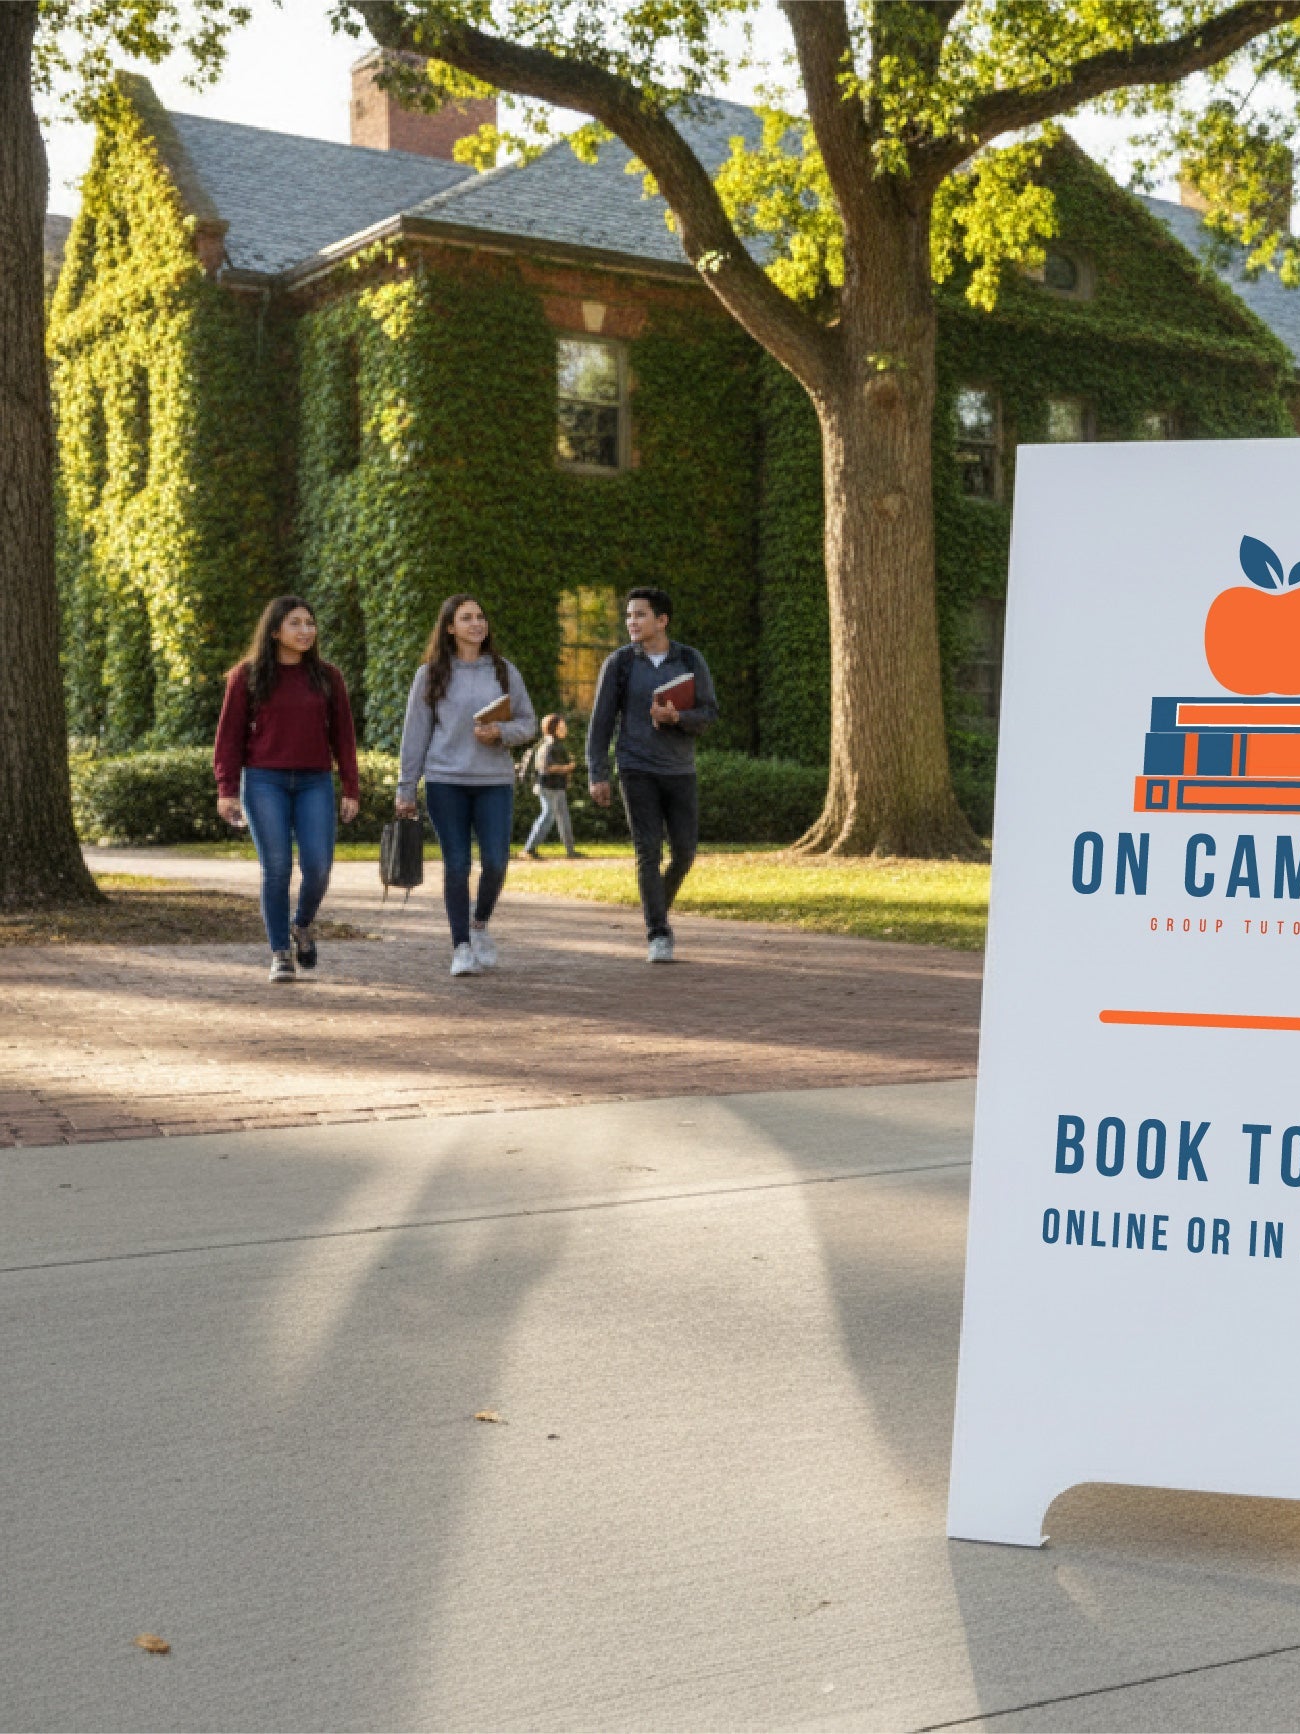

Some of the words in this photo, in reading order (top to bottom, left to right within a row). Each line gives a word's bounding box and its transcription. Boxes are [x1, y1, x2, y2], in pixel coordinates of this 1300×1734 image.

[1072, 831, 1150, 896] ON
[1149, 917, 1224, 933] GROUP
[1055, 1114, 1212, 1182] BOOK
[1042, 1207, 1170, 1252] ONLINE
[1187, 1216, 1231, 1256] OR
[1249, 1220, 1284, 1259] IN
